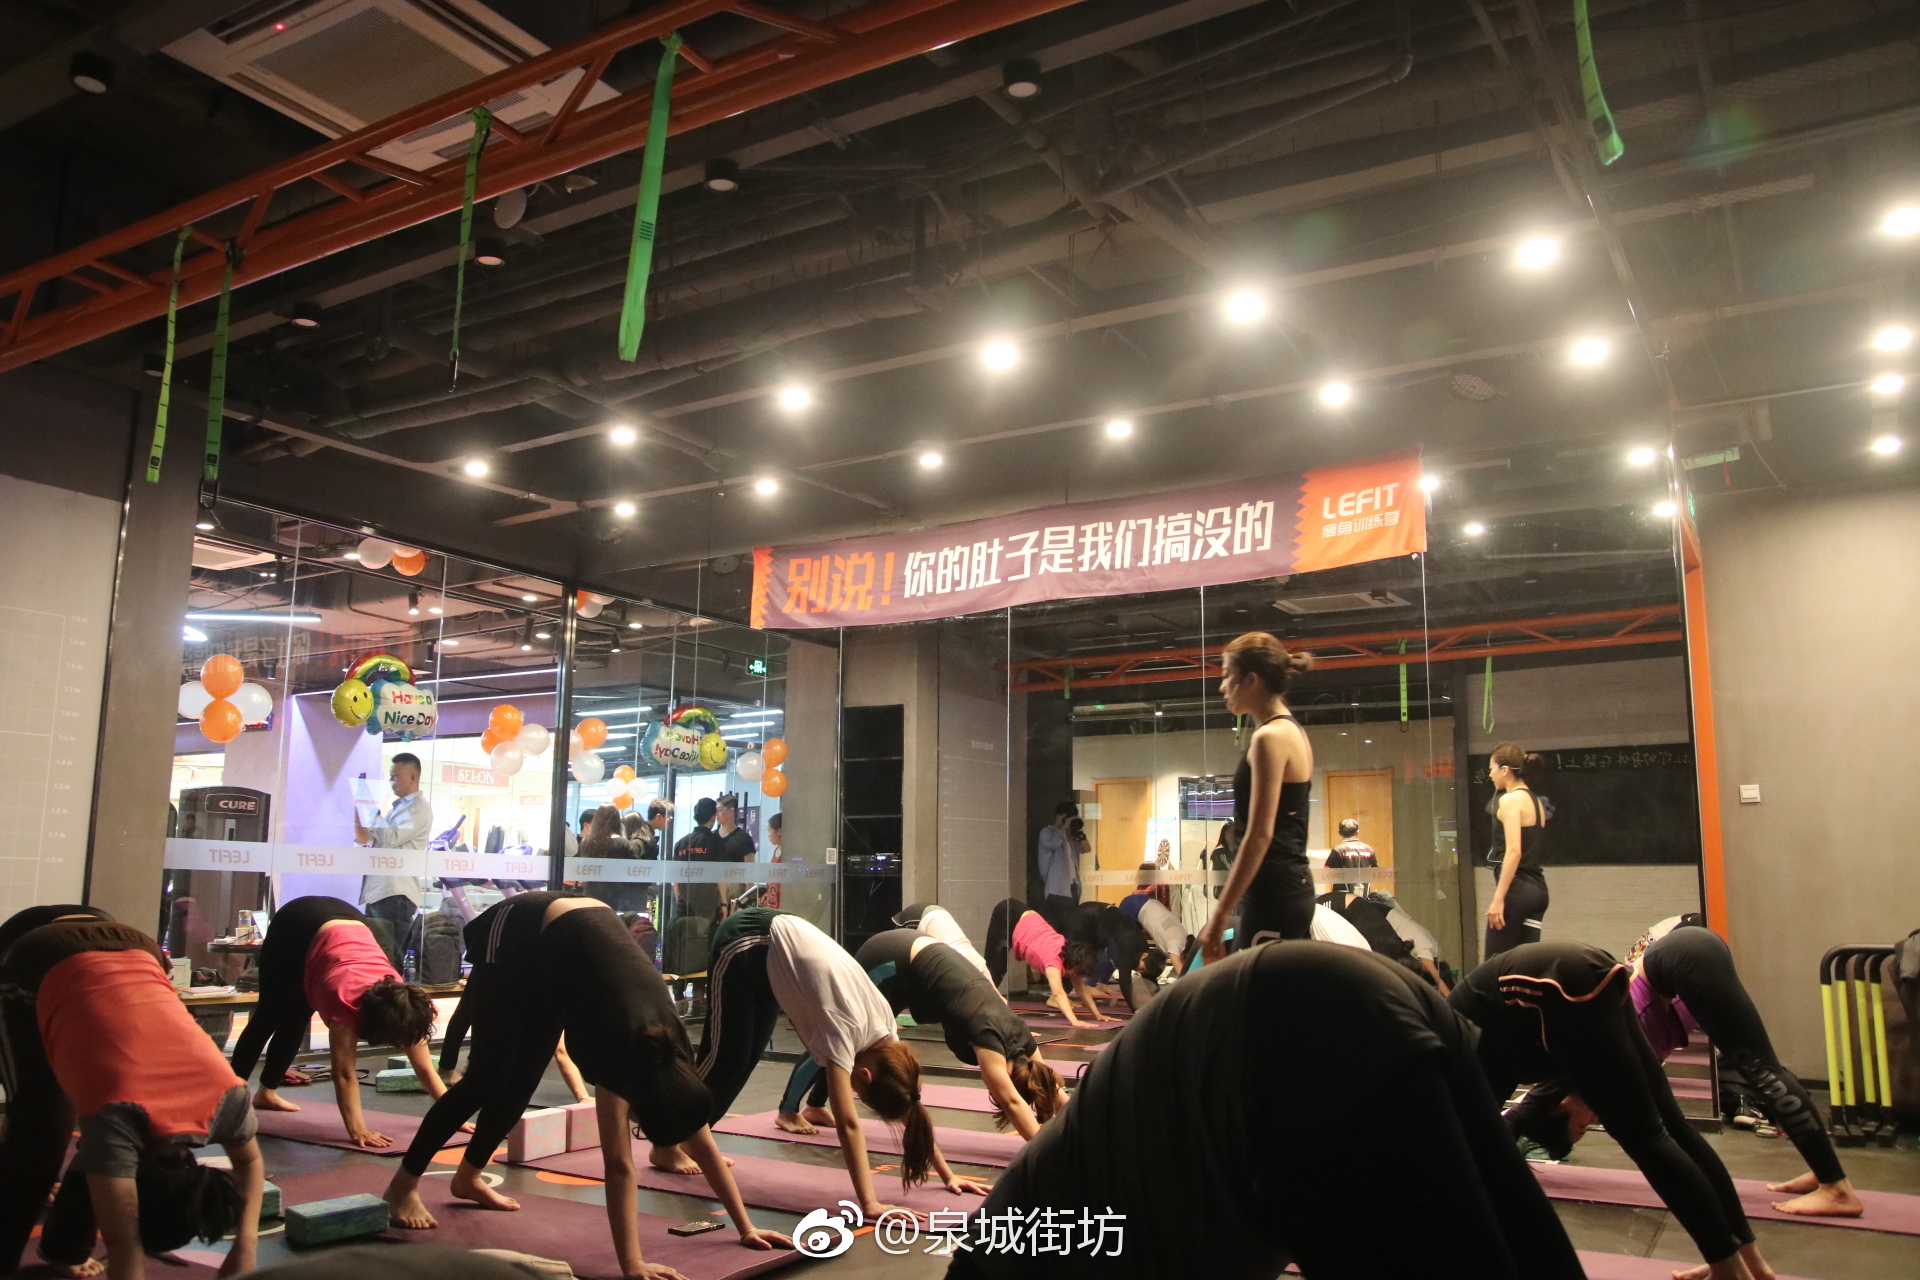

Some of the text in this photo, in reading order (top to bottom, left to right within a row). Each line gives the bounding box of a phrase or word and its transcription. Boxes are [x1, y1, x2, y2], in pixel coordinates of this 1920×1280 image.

[1323, 482, 1399, 520] LEFIT
[1321, 510, 1400, 538] 瘦身训练营
[904, 499, 1274, 598] 你的肚子是我们搞没的
[391, 690, 433, 706] Have a
[383, 710, 415, 725] Nice
[457, 768, 496, 785] SELON
[218, 799, 256, 811] CURE
[576, 864, 603, 876] LEFIT
[627, 865, 652, 877] LEFIT
[680, 867, 704, 878] LEFIT
[724, 868, 746, 879] LEFIT
[1169, 873, 1192, 882] LEFIT
[1321, 872, 1346, 881] LEFIT
